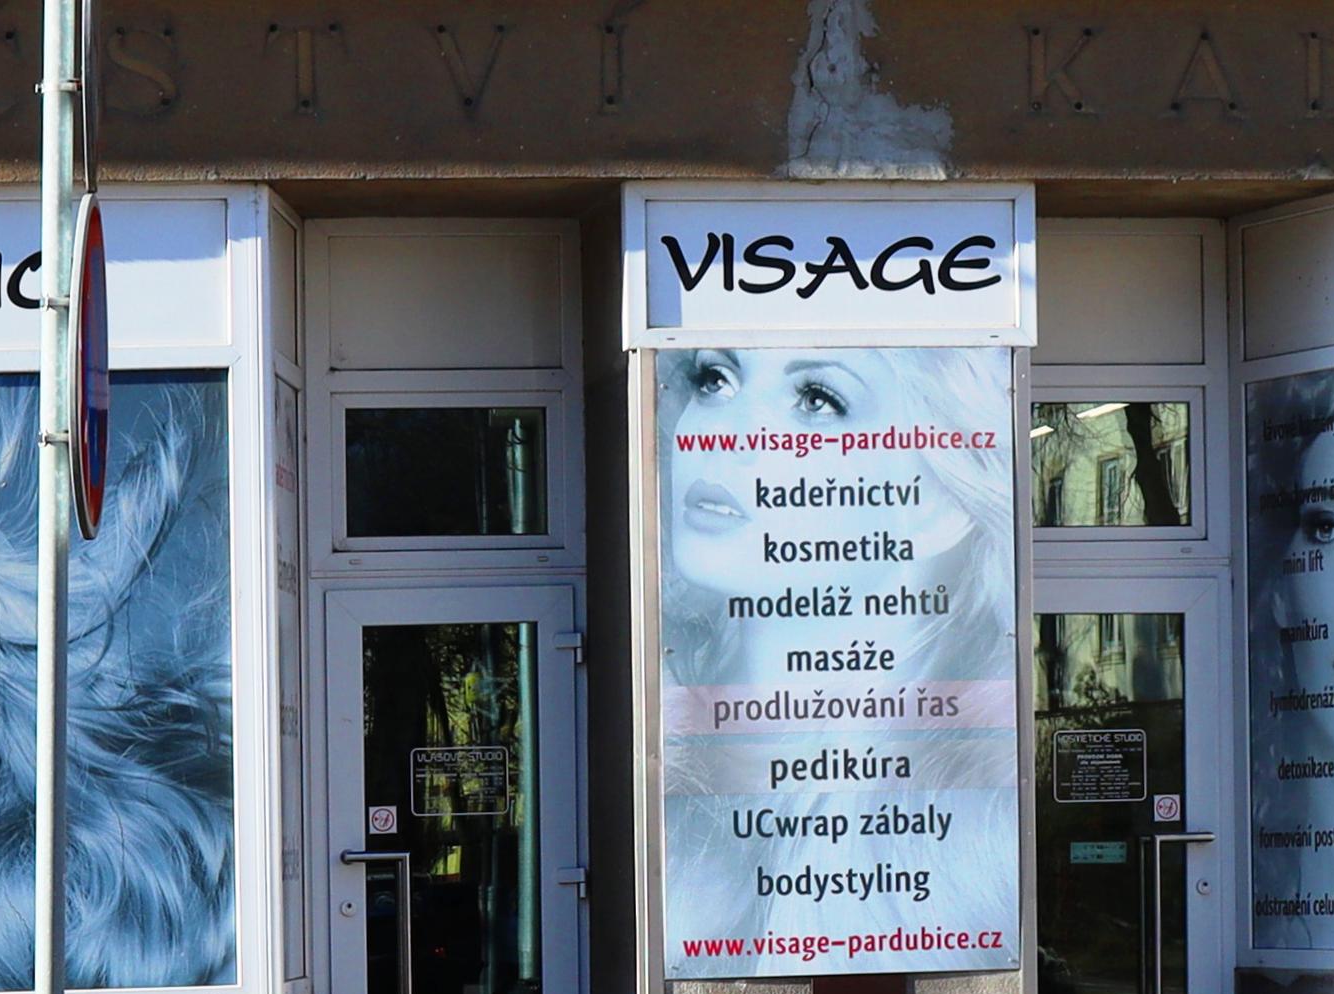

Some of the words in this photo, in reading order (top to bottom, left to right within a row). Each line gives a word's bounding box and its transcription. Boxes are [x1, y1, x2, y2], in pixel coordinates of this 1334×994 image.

[660, 230, 1002, 299] VISAGE
[676, 425, 997, 458] www.visage-pardubice.cz
[755, 475, 922, 510] kadeřnictví
[1259, 478, 1327, 513] prodžování
[763, 532, 914, 564] kosmetika
[1282, 552, 1306, 575] mini
[1309, 548, 1324, 572] lift
[728, 586, 853, 619] modeláž
[864, 584, 950, 616] nehtů
[1279, 618, 1329, 642] manikúra
[786, 640, 896, 672] masáže
[713, 689, 907, 729] prodlužování
[916, 687, 960, 718] řas
[770, 747, 912, 789] pedikúra
[1277, 758, 1334, 780] detoxikace
[732, 809, 849, 843] UCwrap
[859, 804, 953, 841] zábaly
[1258, 824, 1312, 849] formování
[757, 863, 931, 902] bodystyling
[1255, 893, 1310, 917] odstranění
[683, 926, 1003, 961] www.visage-pardubice.cz
